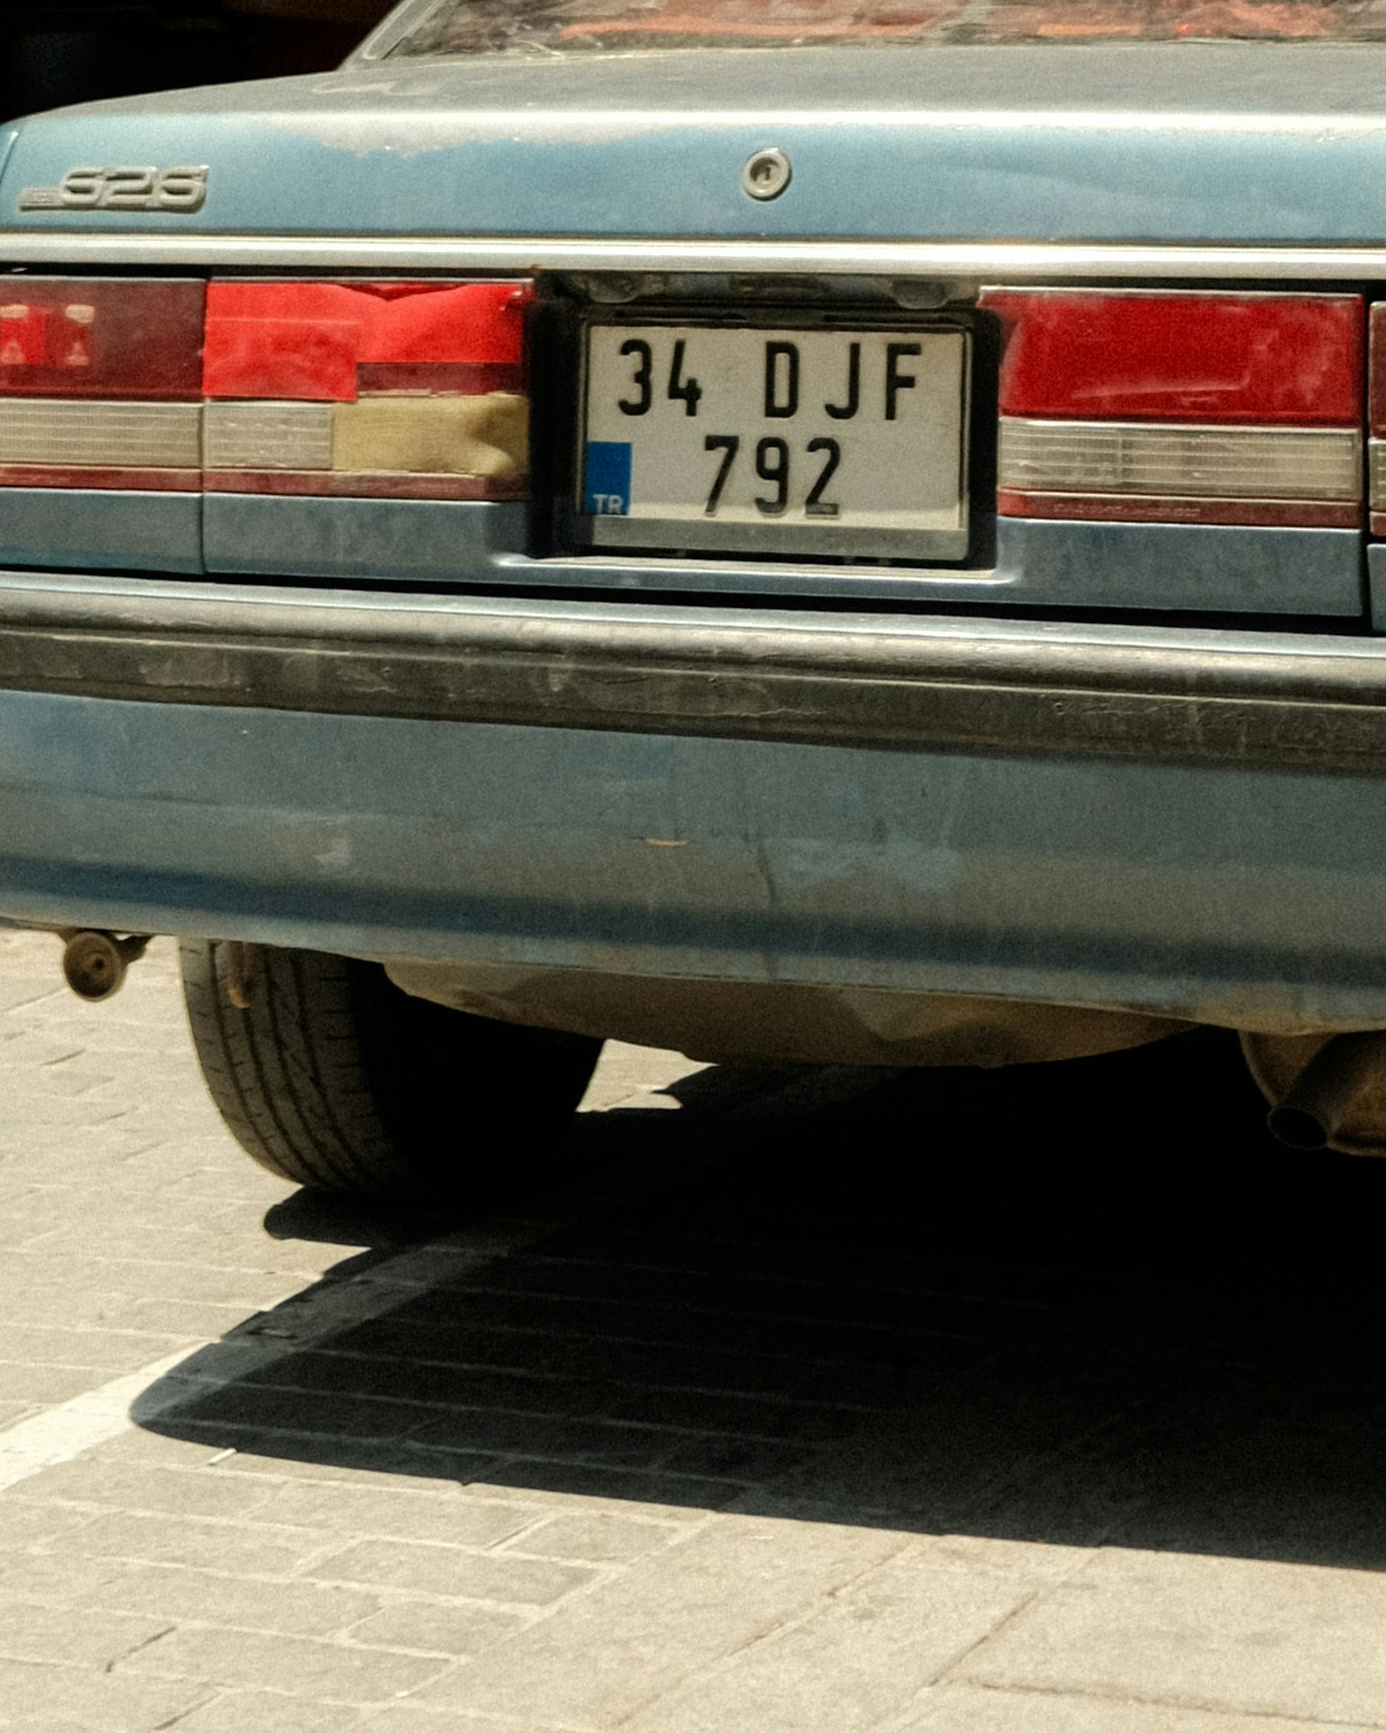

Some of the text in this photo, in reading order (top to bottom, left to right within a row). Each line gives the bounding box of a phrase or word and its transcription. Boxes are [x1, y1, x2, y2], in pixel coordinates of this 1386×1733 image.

[618, 339, 921, 420] 34 DJF
[592, 492, 625, 515] TR
[704, 435, 841, 520] 792
